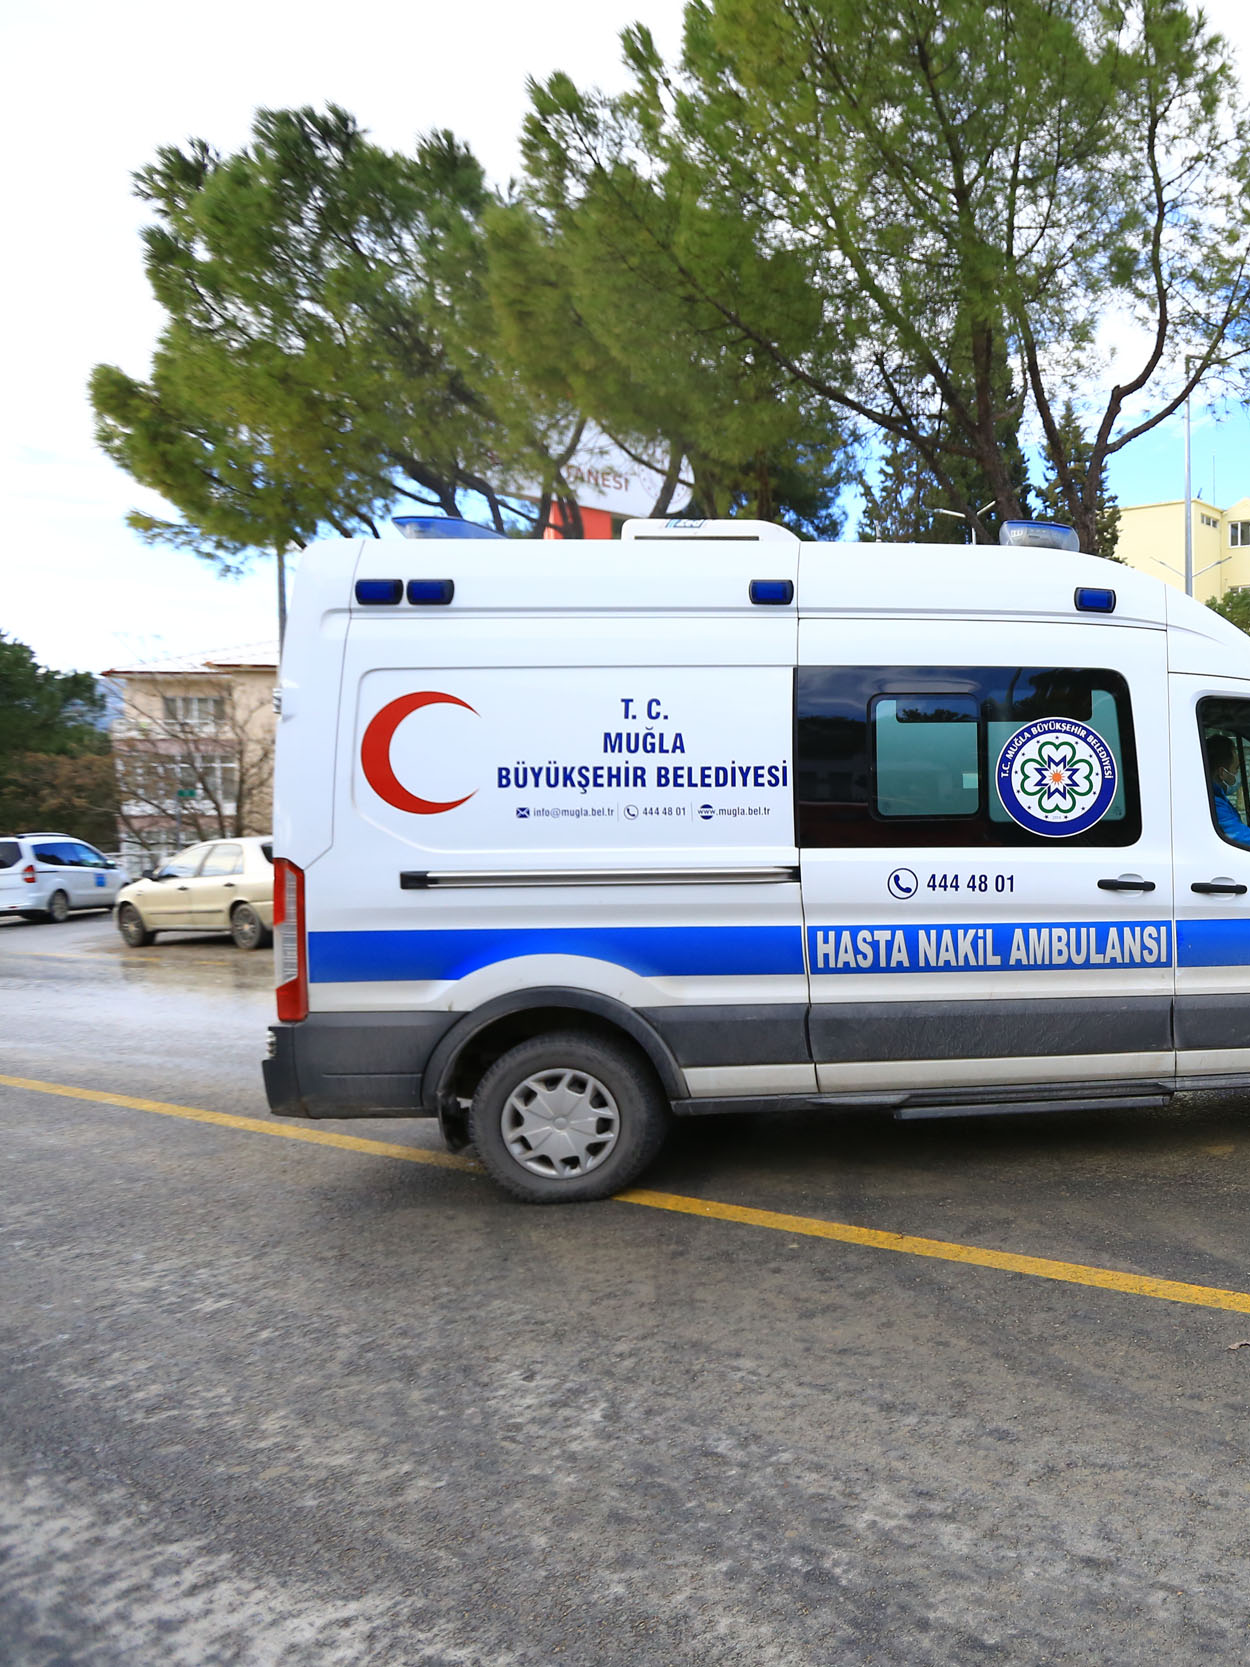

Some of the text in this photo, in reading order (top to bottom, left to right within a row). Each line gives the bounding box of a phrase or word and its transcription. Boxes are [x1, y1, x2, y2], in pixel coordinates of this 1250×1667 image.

[620, 698, 668, 720] T. C.
[603, 726, 686, 754] MUĞLA
[1001, 721, 1114, 779] T.C. MUĞLA BÜYÜKŞEHİR BELEDİYESİ
[497, 760, 788, 794] BÜYÜKŞEHİR BELEDİYESİ
[533, 807, 614, 818] info@mugla.bel.tr
[643, 807, 687, 817] 444 48 01
[698, 806, 770, 818] www.mugla.bel.tr
[926, 873, 1015, 892] 444 48 01
[816, 929, 910, 969] HASTA
[1009, 925, 1167, 965] AMBULANSI
